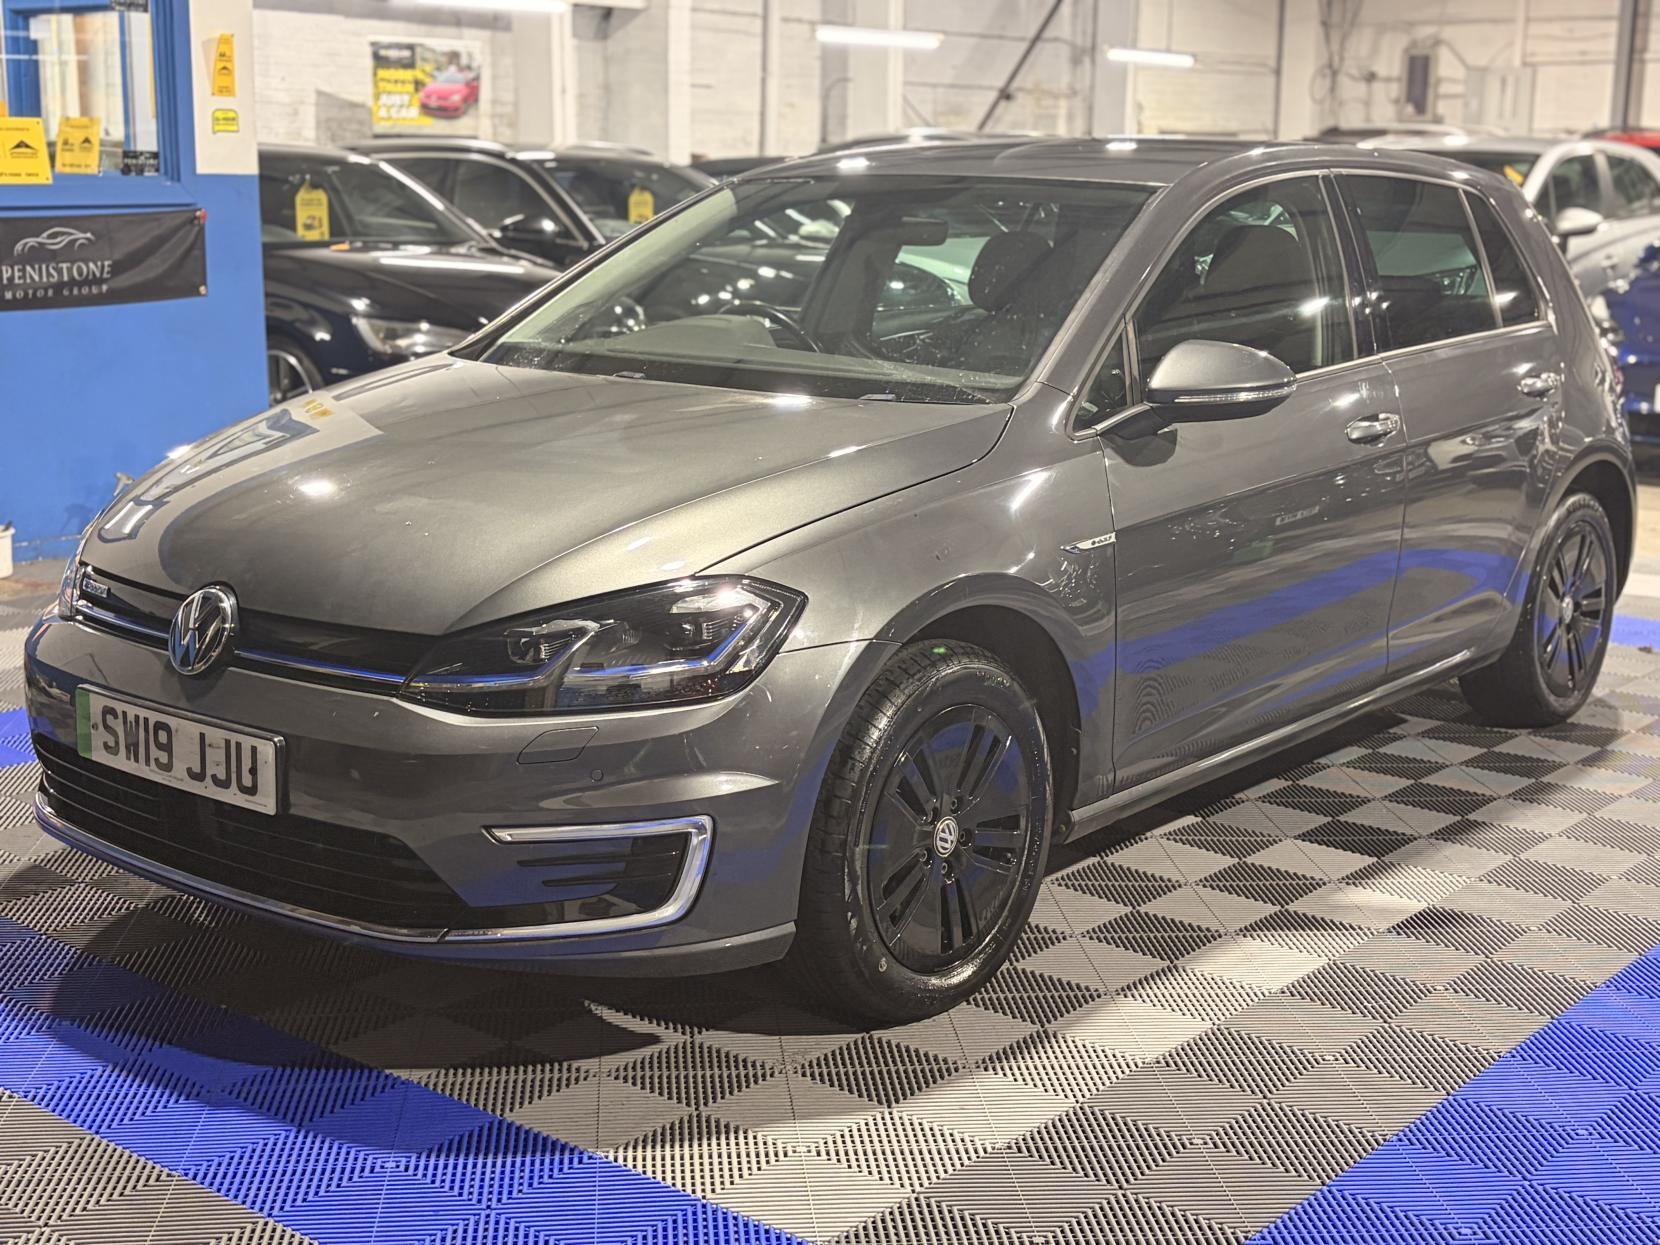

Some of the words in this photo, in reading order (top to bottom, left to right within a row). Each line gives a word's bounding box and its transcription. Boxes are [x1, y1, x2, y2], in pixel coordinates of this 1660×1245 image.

[1, 260, 112, 284] PENISTONE
[4, 287, 55, 300] MOTOR
[62, 284, 109, 297] GROUP
[102, 705, 173, 773] SW19
[185, 732, 258, 797] JJU
